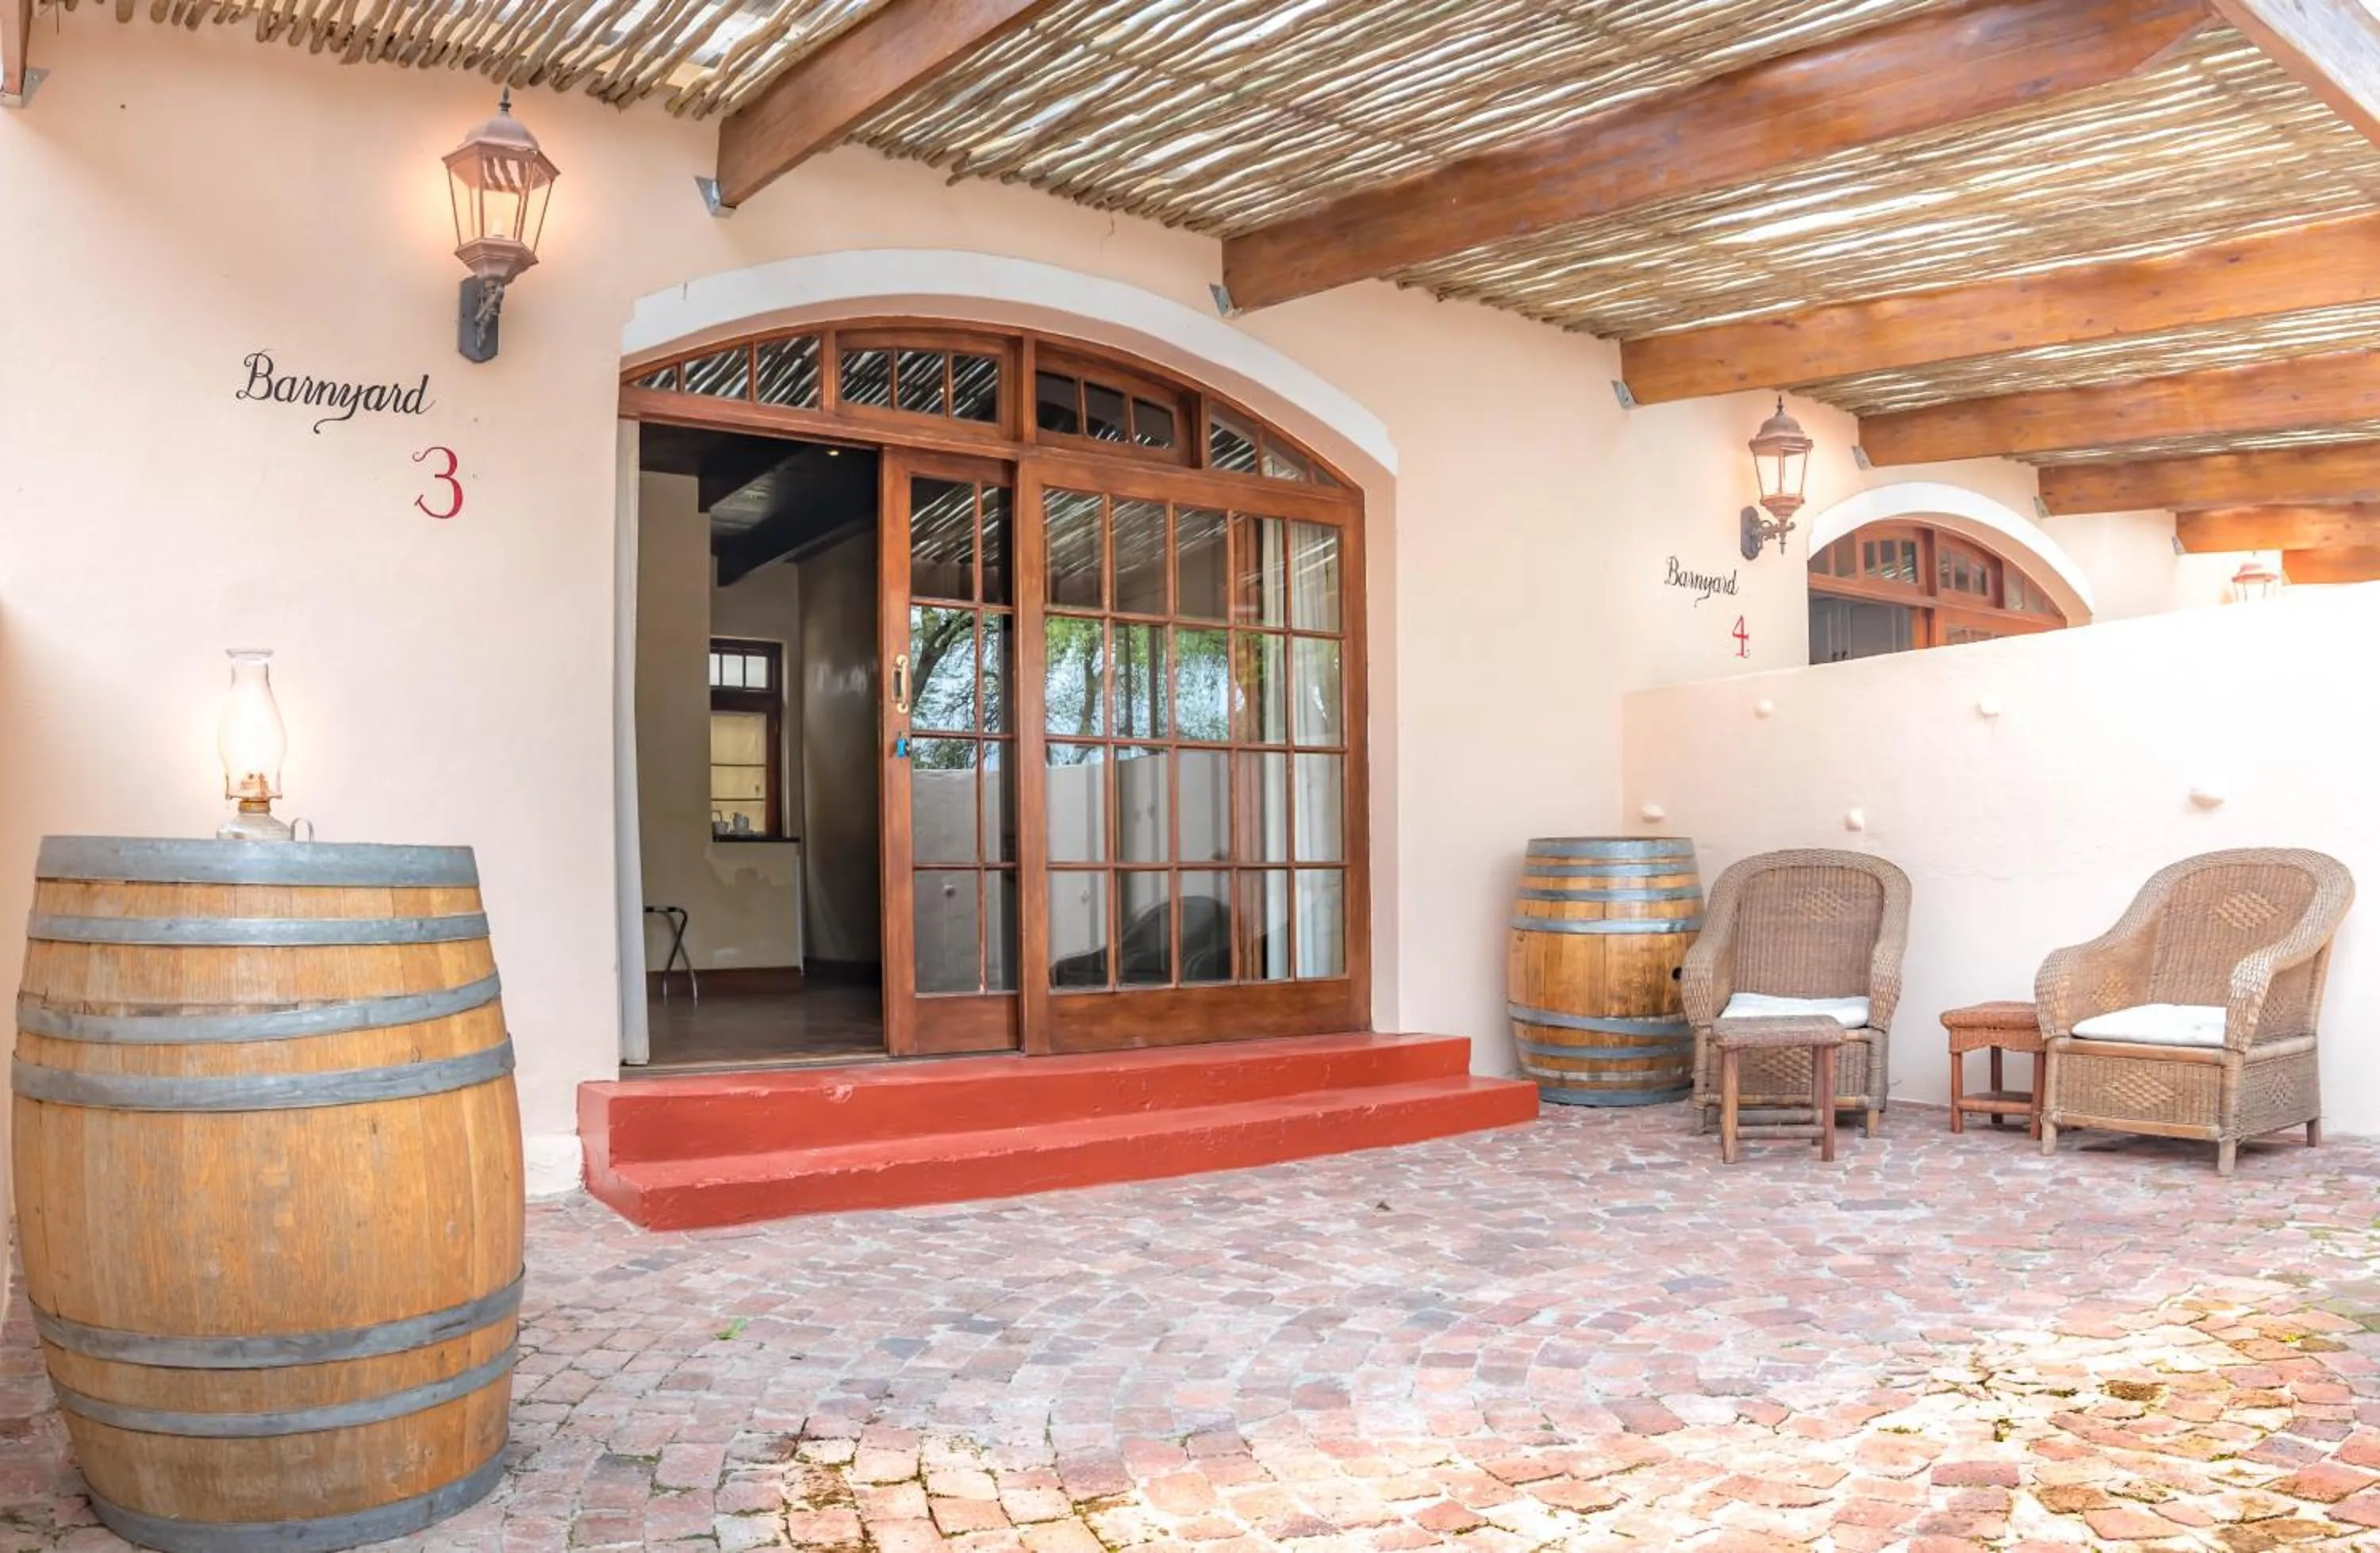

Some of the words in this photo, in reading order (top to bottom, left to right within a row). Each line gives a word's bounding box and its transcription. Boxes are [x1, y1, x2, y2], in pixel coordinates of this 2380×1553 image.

[236, 349, 436, 434] Barnyard
[412, 447, 463, 520] 3
[1664, 555, 1739, 608] Barnyard
[1732, 615, 1750, 658] 4
